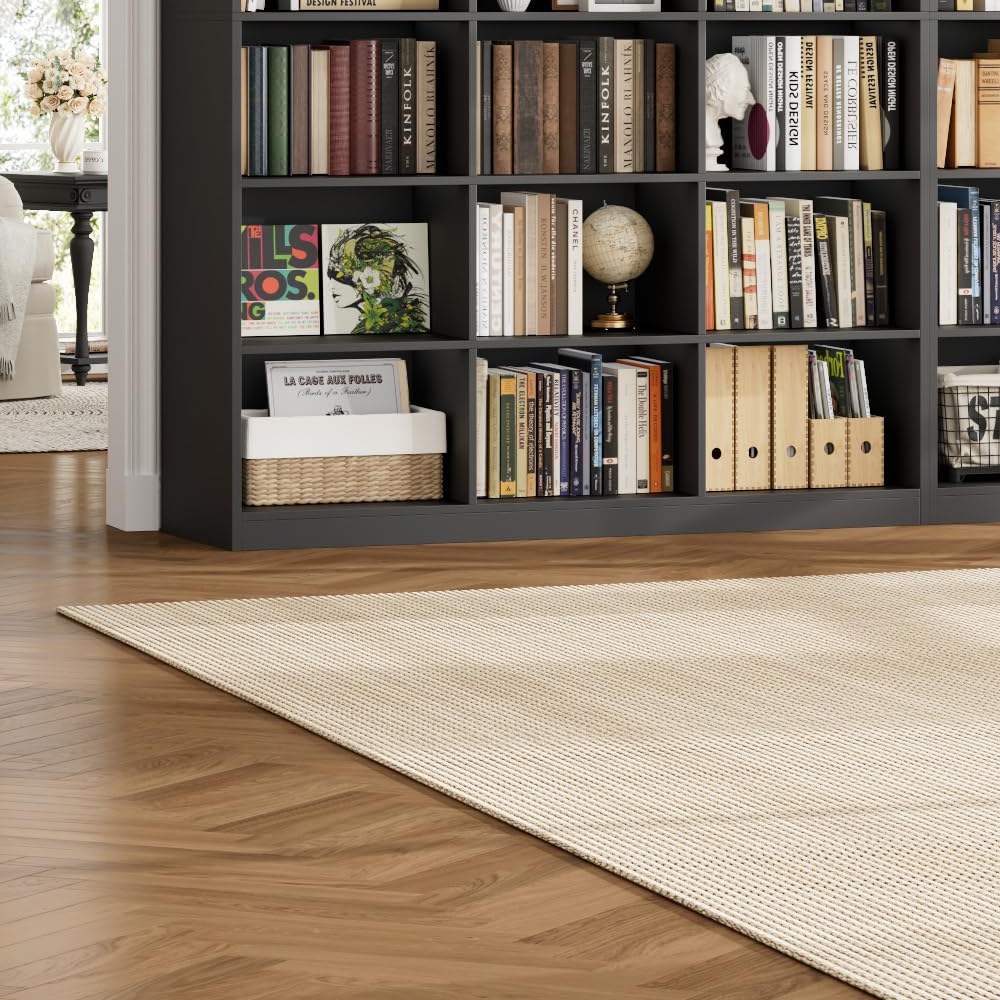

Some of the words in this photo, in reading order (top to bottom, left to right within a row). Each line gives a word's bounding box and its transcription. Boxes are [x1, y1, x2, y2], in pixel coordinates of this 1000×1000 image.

[403, 67, 412, 145] KINFOLK
[601, 65, 610, 144] KINFOLK
[624, 106, 633, 168] MANOLO
[815, 217, 828, 240] IMPRO
[284, 376, 297, 386] LA
[327, 375, 347, 385] AUX
[349, 374, 383, 384] FOLLES
[638, 384, 646, 396] The
[638, 397, 646, 420] Double
[638, 421, 647, 438] Helix
